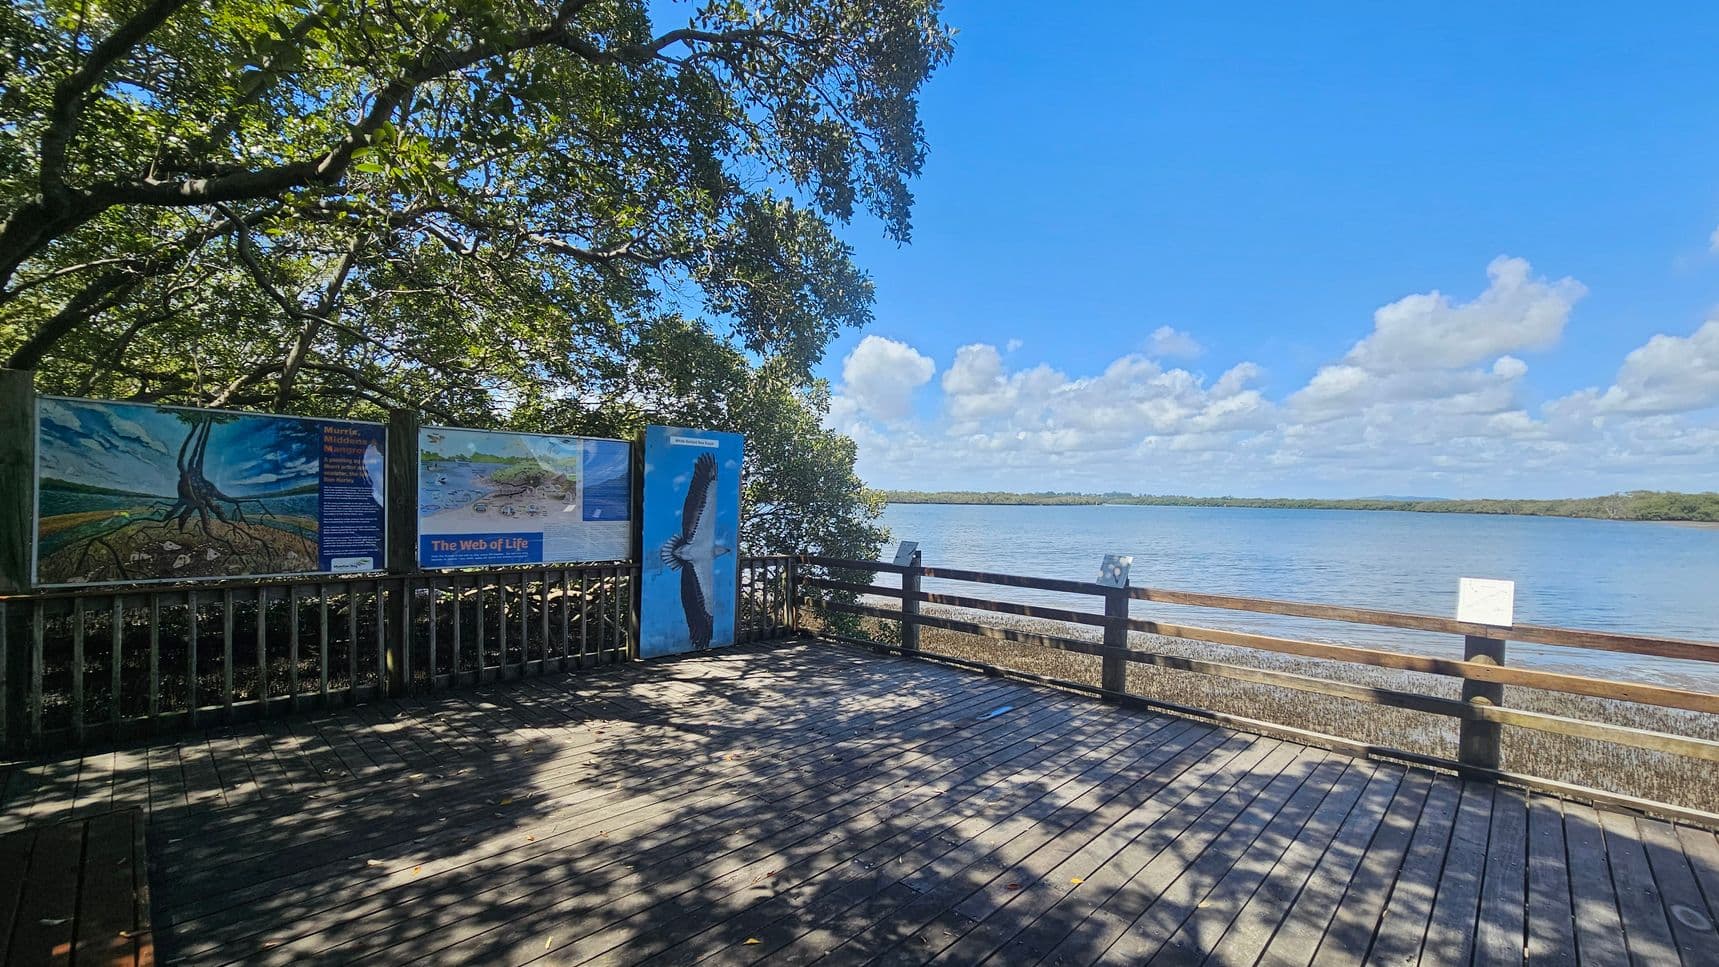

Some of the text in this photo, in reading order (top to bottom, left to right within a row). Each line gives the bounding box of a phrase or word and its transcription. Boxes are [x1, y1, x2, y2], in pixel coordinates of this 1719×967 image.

[324, 435, 368, 446] Middens
[431, 537, 529, 552] The Web of Life
